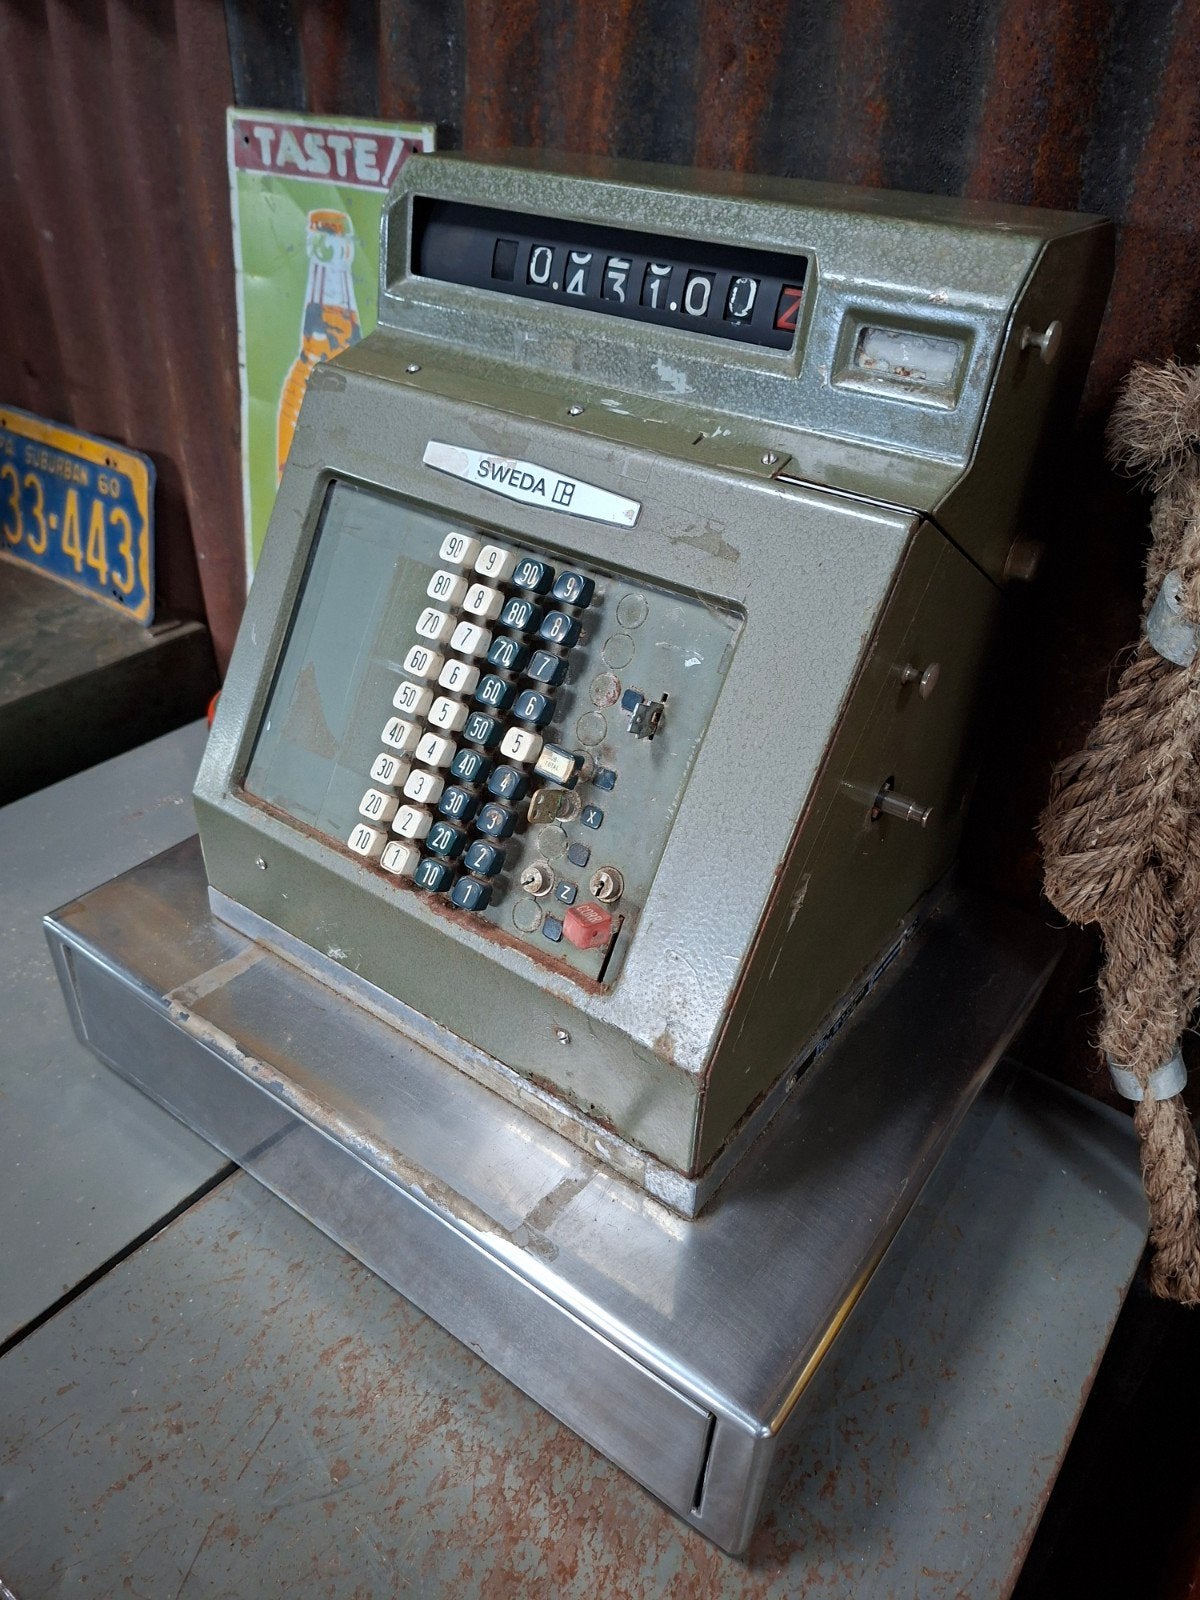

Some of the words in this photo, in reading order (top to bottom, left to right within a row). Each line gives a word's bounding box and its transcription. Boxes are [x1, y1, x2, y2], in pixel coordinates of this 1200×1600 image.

[253, 126, 404, 186] TASTE!
[477, 459, 546, 497] SWEDA
[446, 537, 464, 557] 90
[486, 551, 497, 570] 9
[433, 574, 451, 595] 80
[522, 562, 538, 588] 90
[563, 577, 577, 597] 9
[473, 590, 485, 609] 8
[423, 612, 440, 633] 70
[508, 602, 525, 628] 80
[461, 627, 473, 646] 7
[550, 617, 562, 637] 8
[410, 651, 428, 671] 60
[493, 640, 513, 666] 70
[450, 666, 461, 685] 6
[536, 656, 550, 676] 7
[400, 685, 416, 707] 50
[482, 680, 499, 704] 60
[438, 703, 450, 722] 5
[525, 696, 537, 716] 6
[389, 722, 405, 743] 40
[470, 718, 488, 740] 50
[427, 740, 437, 758] 4
[511, 734, 523, 754] 5
[377, 758, 393, 779] 30
[458, 752, 476, 775] 40
[414, 777, 426, 795] 3
[500, 772, 513, 792] 4
[365, 794, 382, 817] 20
[445, 791, 464, 814] 30
[402, 812, 413, 831] 2
[586, 809, 597, 824] X
[355, 829, 371, 850] 10
[432, 827, 450, 850] 20
[391, 850, 400, 867] 1
[474, 847, 487, 868] 2
[422, 865, 439, 886] 10
[462, 884, 473, 904] 1
[560, 885, 571, 900] Z
